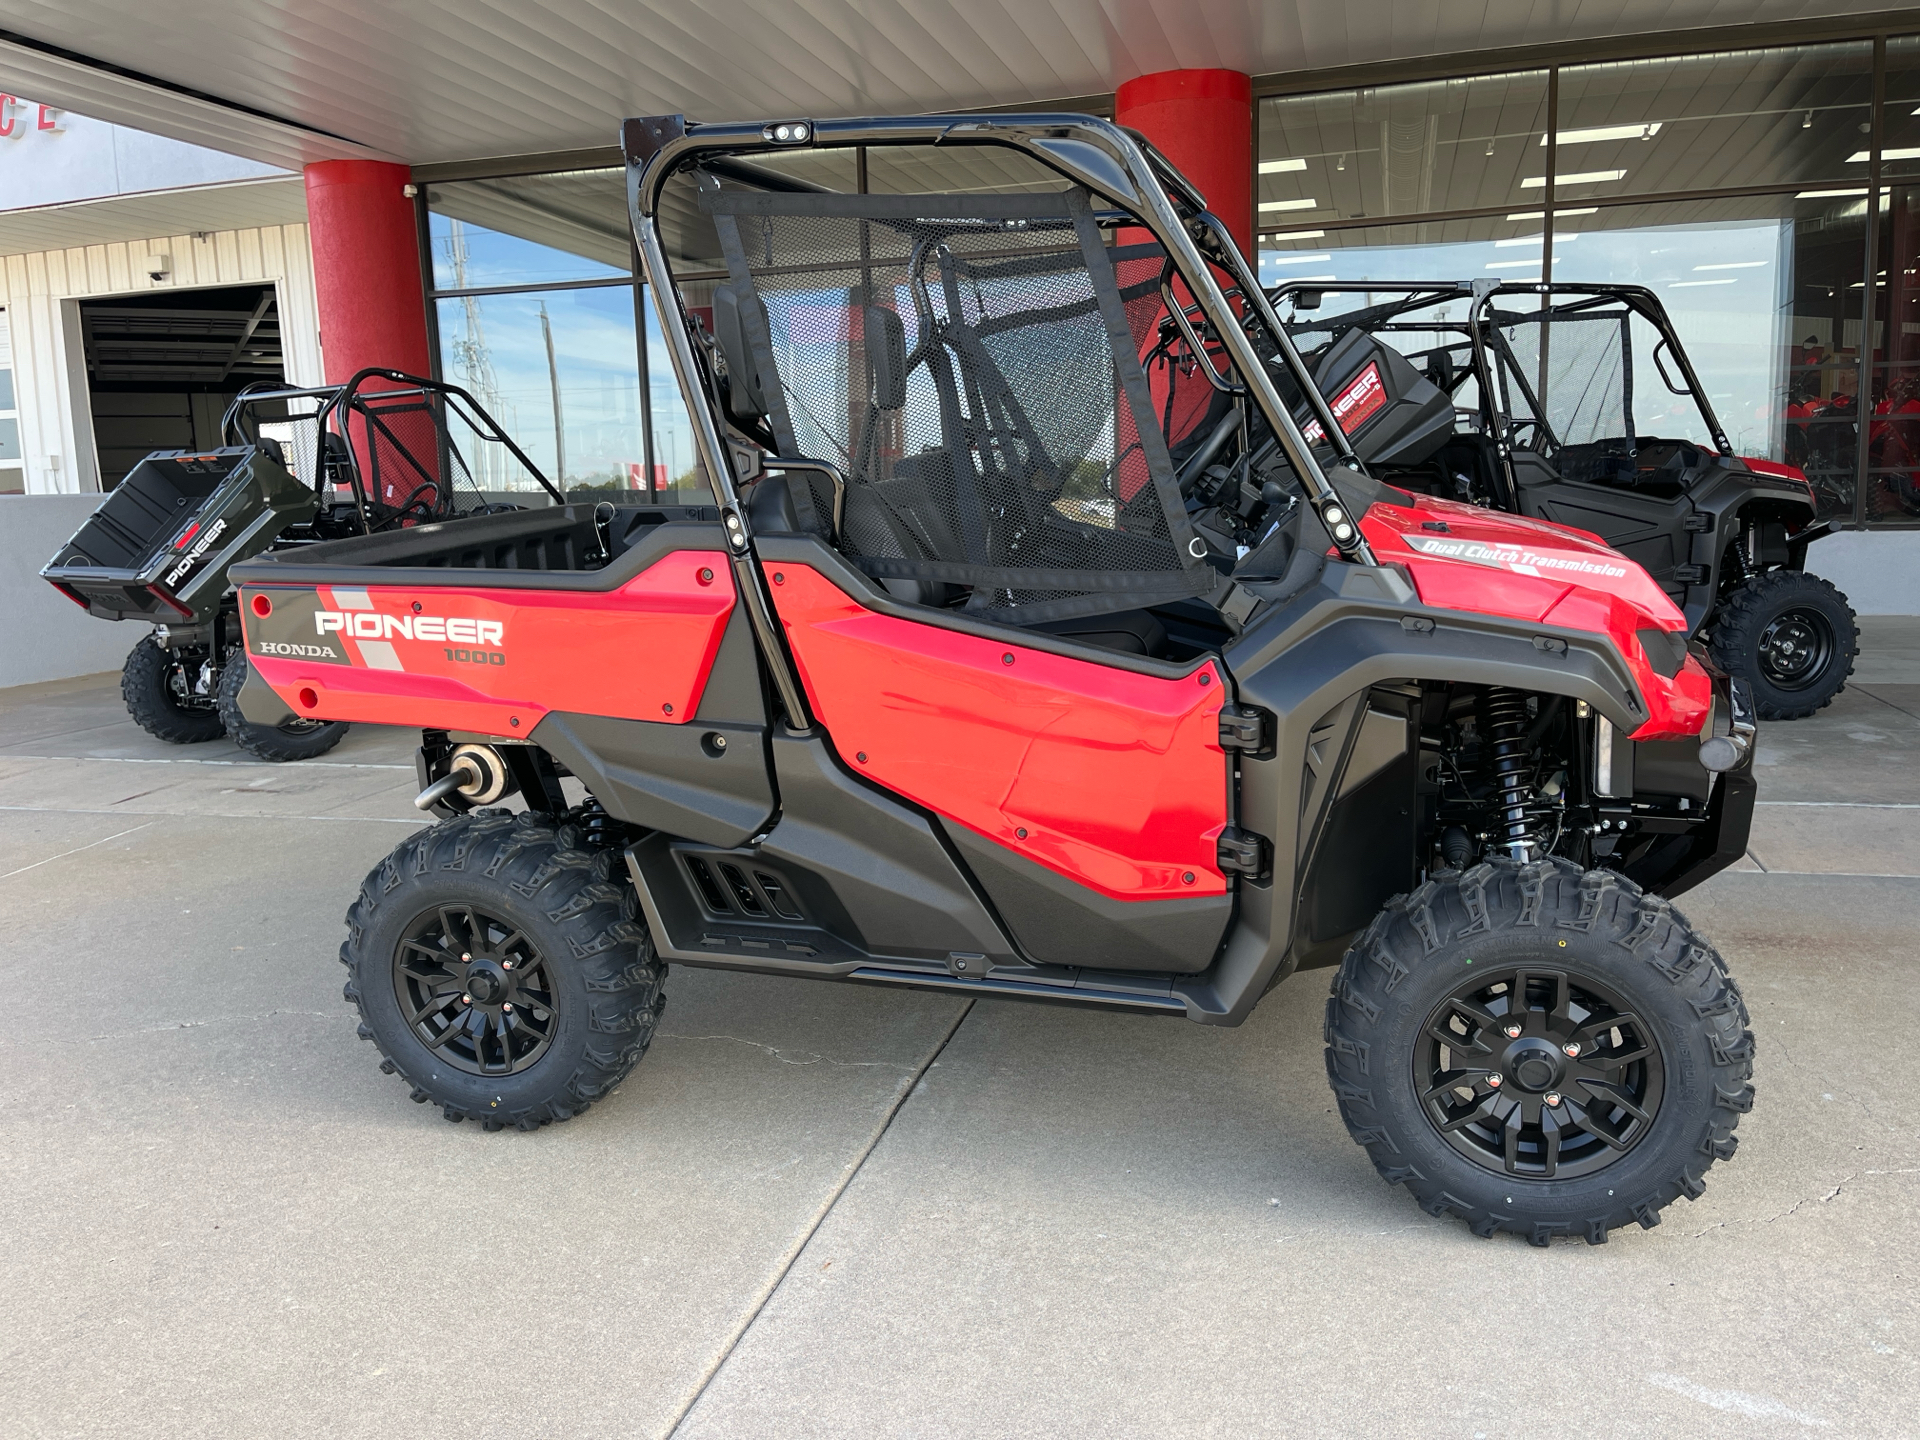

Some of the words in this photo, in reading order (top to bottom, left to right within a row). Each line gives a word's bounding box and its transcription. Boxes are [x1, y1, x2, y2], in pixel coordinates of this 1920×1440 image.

[1347, 398, 1380, 429] HONDA
[165, 518, 228, 588] PIONEER
[1421, 541, 1465, 556] Dual
[1464, 545, 1519, 563] Clutch
[1521, 552, 1627, 578] Transmission
[314, 611, 503, 647] PIONEER
[260, 641, 338, 659] HONDA
[443, 647, 506, 667] 1000
